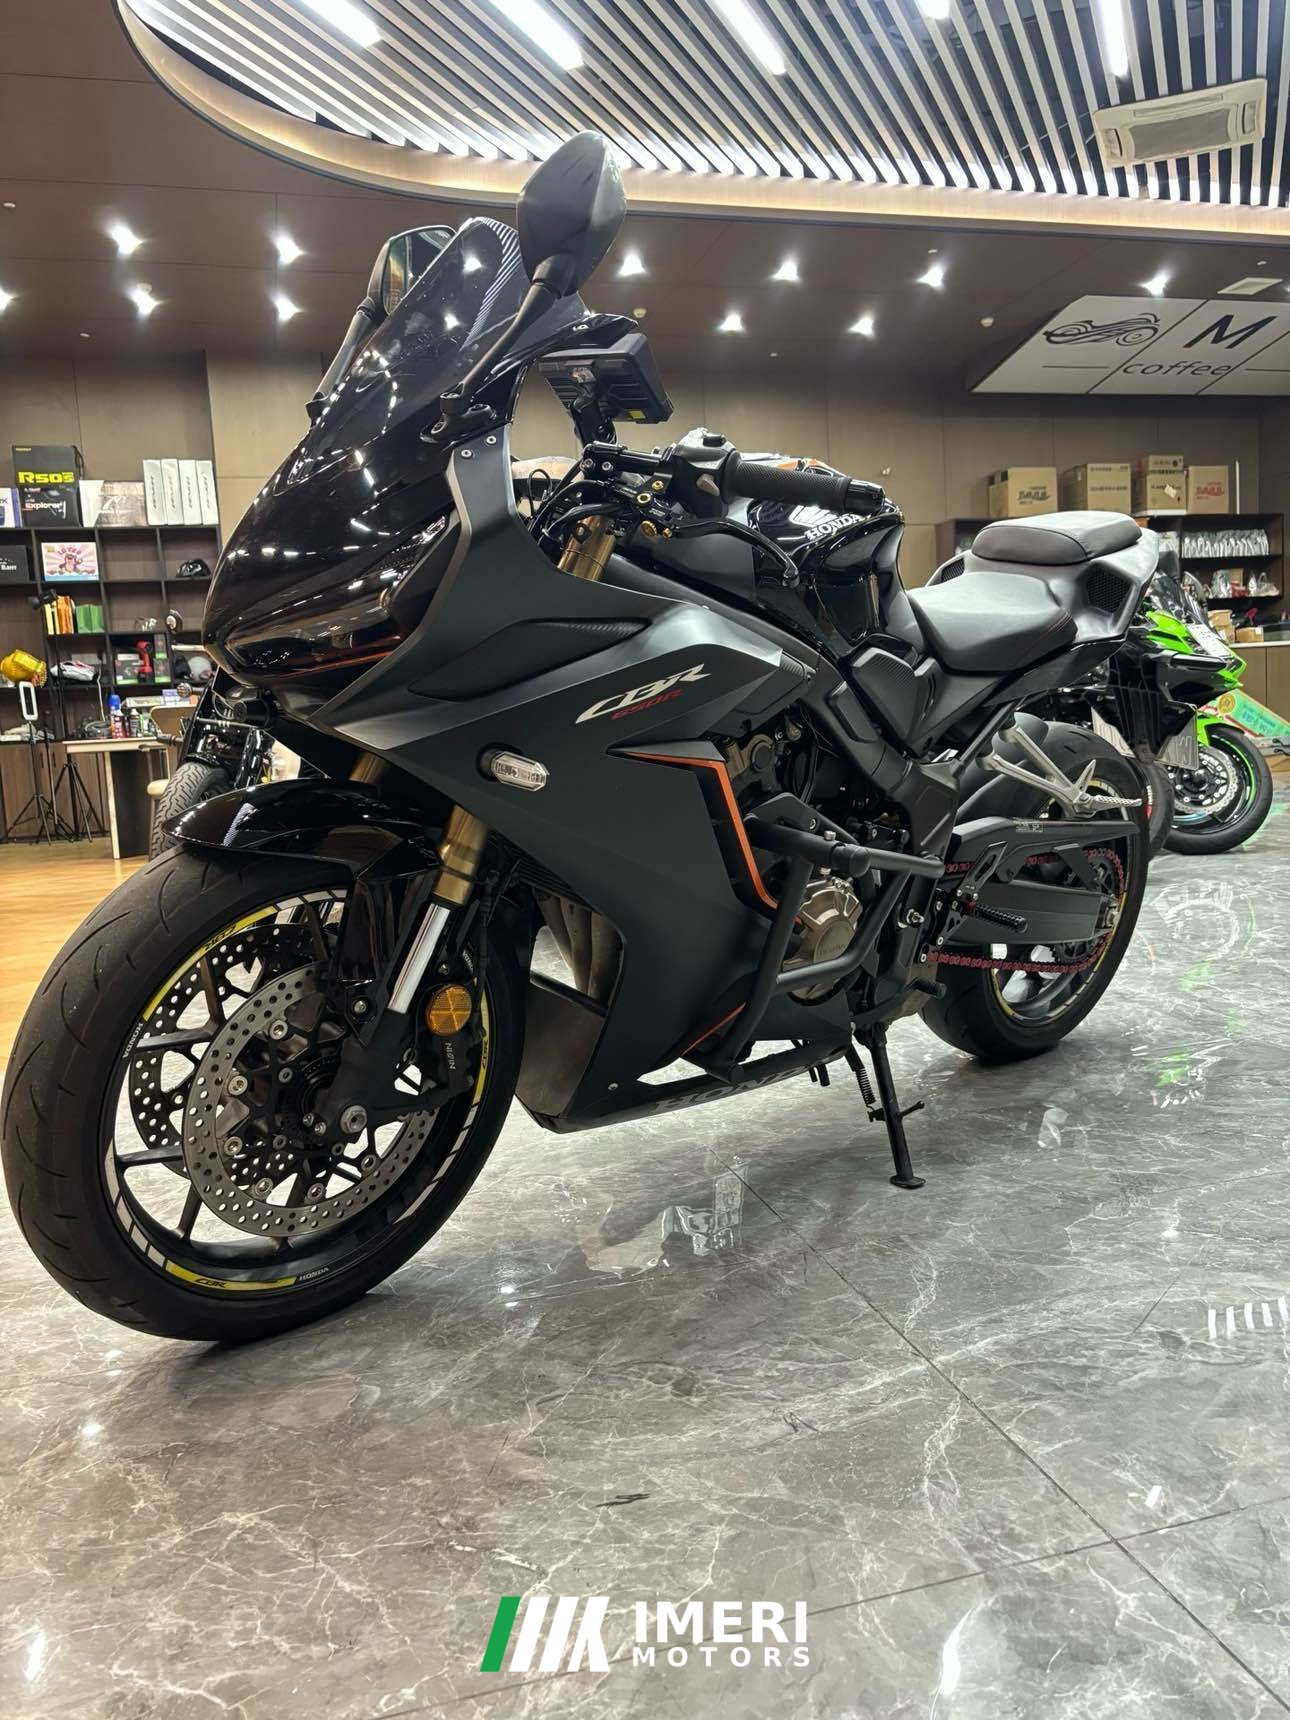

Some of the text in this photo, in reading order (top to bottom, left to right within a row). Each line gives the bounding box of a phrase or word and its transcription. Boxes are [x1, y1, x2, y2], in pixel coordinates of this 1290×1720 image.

[1183, 314, 1277, 349] M
[1122, 361, 1233, 376] coffee
[804, 513, 866, 542] HONDA
[575, 663, 712, 724] CBR
